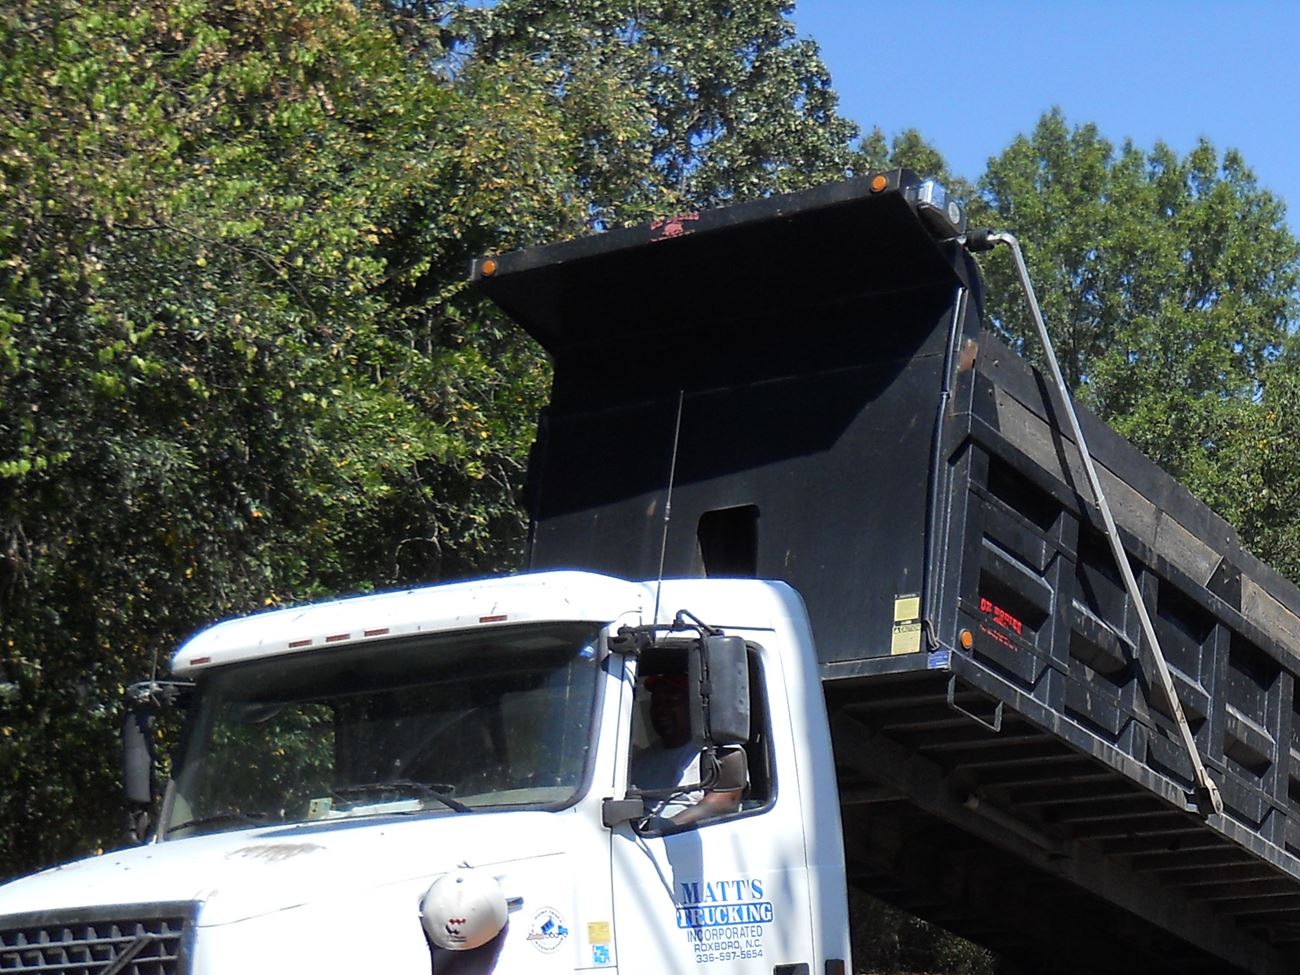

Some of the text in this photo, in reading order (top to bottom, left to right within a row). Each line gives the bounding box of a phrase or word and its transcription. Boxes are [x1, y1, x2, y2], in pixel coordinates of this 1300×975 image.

[680, 879, 764, 904] MATT'S
[677, 904, 771, 926] TRUCKING
[687, 925, 763, 943] INCORPORATED
[694, 938, 763, 952] ROXBORO, N.C.
[696, 949, 763, 963] 336-597-5654
